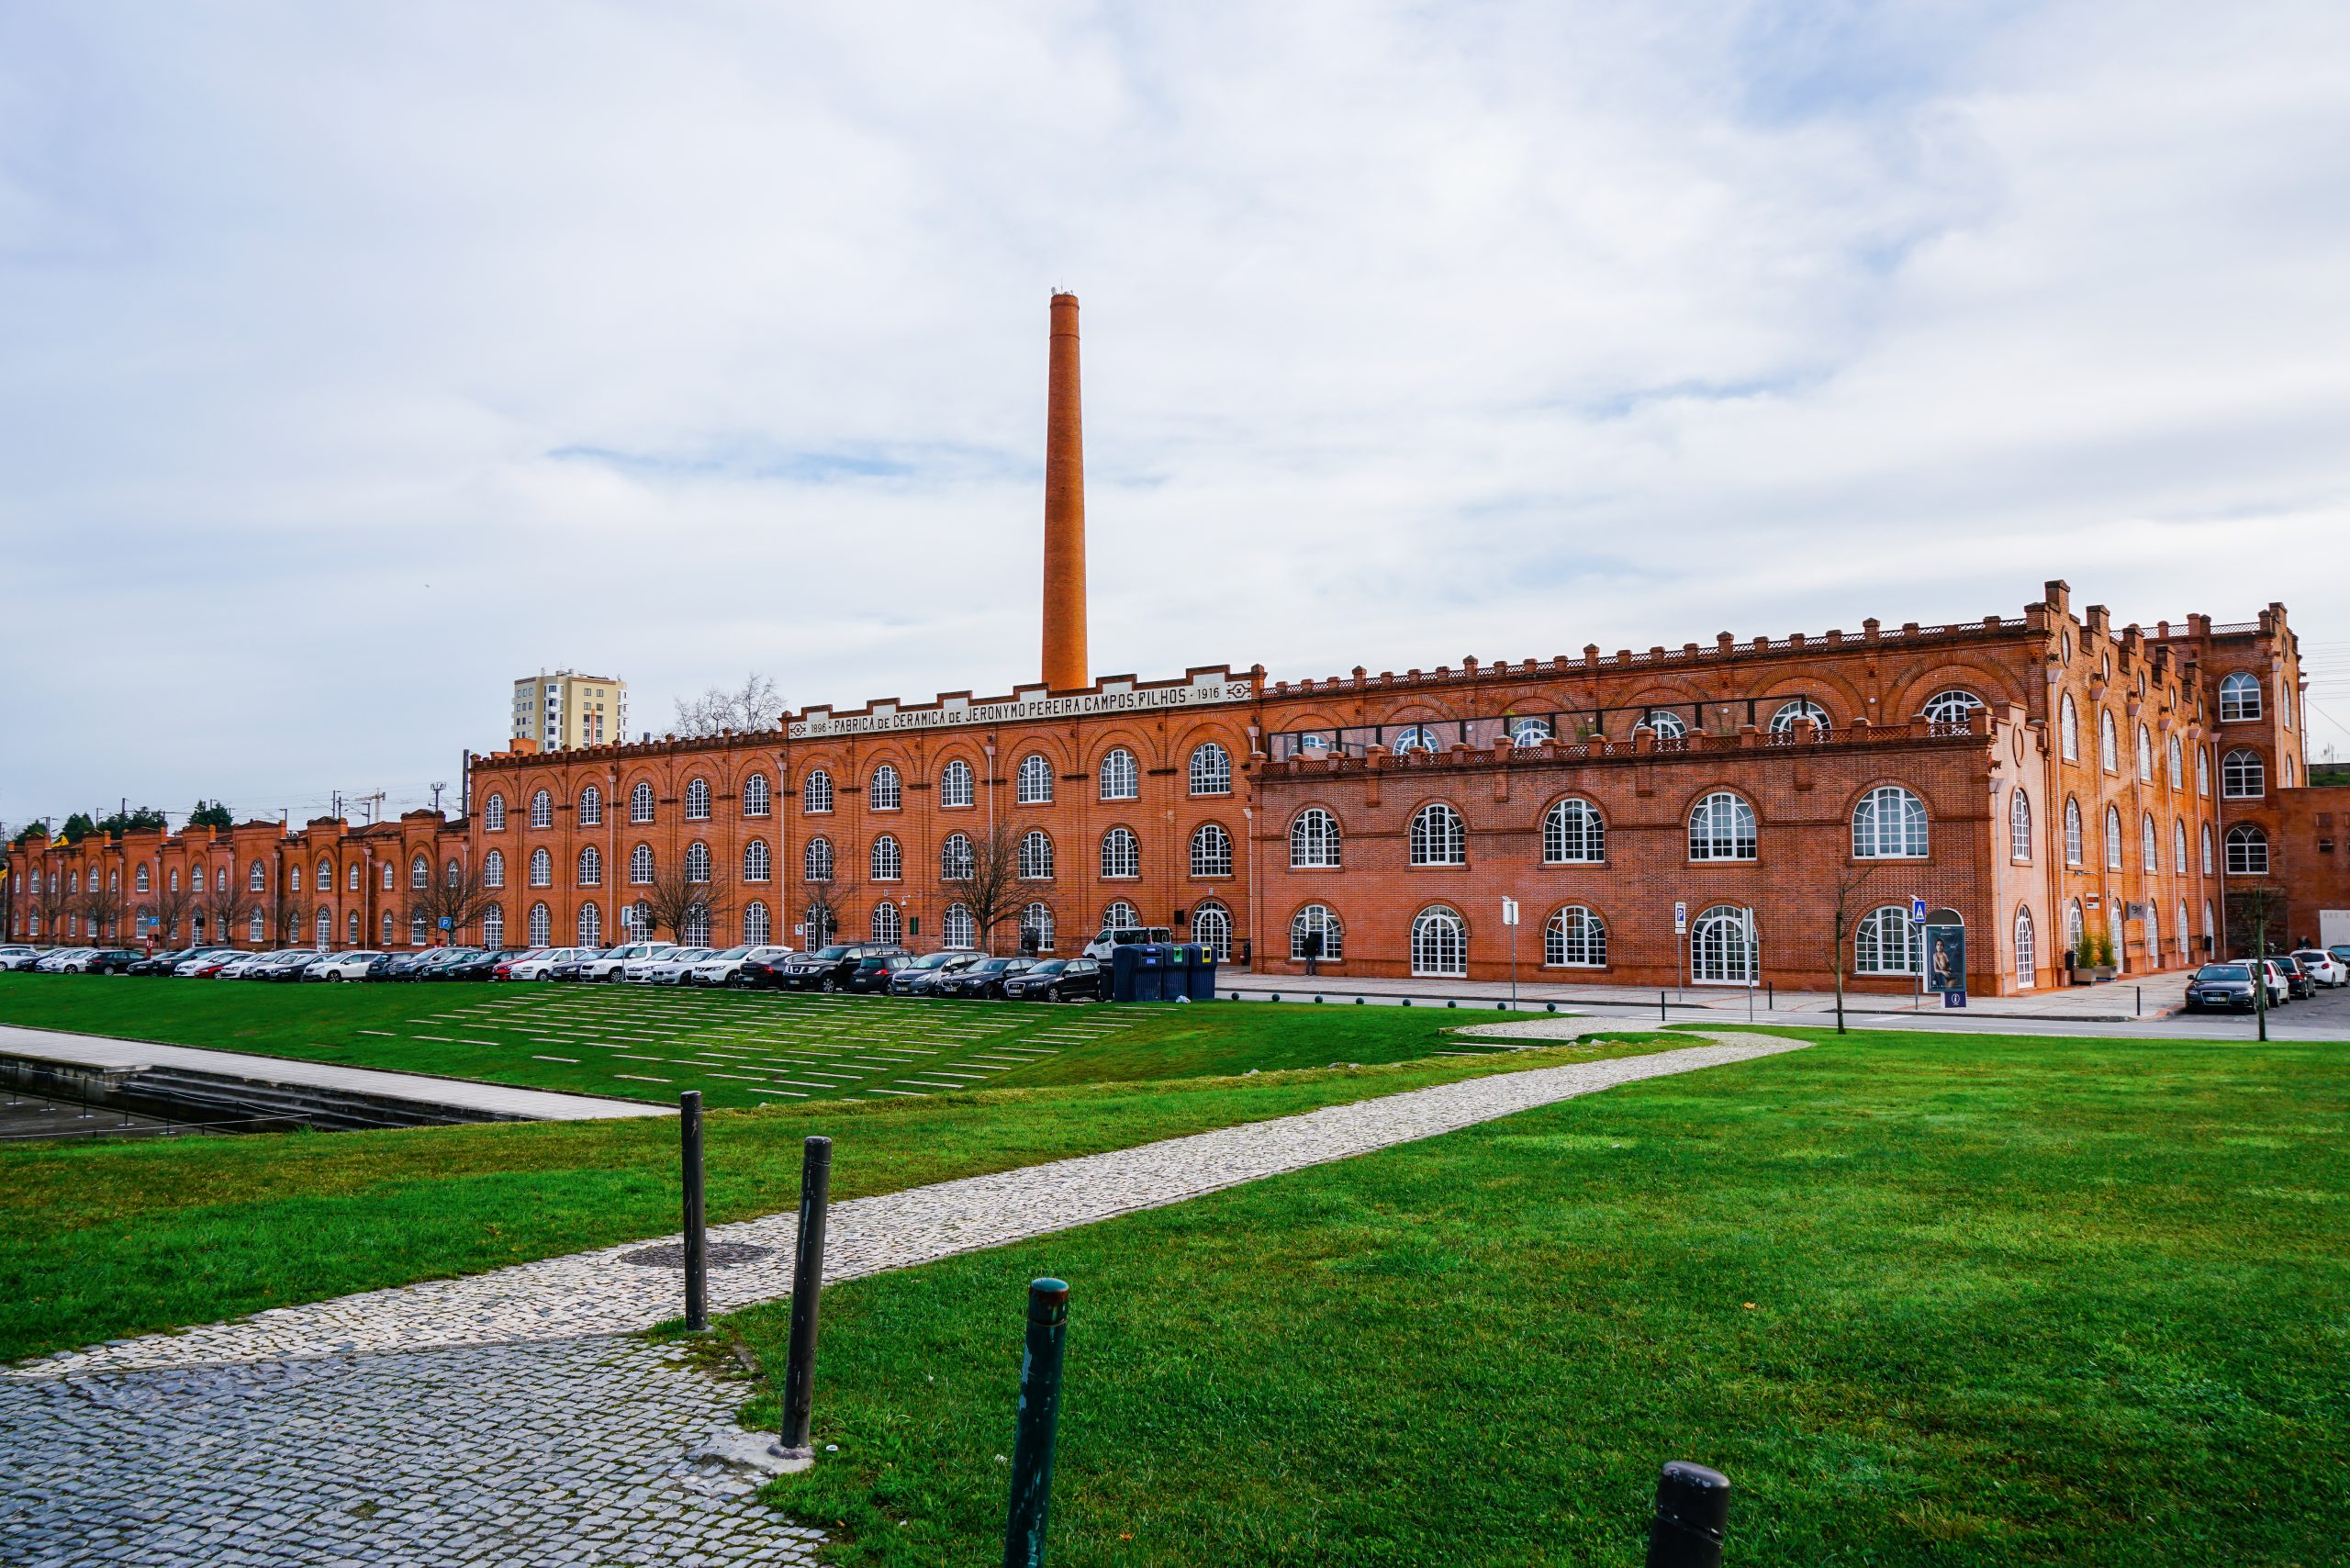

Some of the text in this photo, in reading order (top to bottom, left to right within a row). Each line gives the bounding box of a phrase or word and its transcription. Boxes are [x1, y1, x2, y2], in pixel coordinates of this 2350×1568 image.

[811, 722, 826, 734] 1896
[878, 718, 890, 730] DE
[893, 711, 945, 728] CERAMICA
[948, 711, 961, 723] DE
[966, 702, 1025, 722] JERONYMO
[1029, 698, 1080, 716] PEREIRA
[1084, 692, 1136, 712] CAMPOS,
[1138, 689, 1186, 707] FILHOS
[1197, 687, 1220, 700] 1916
[1678, 909, 1684, 921] P
